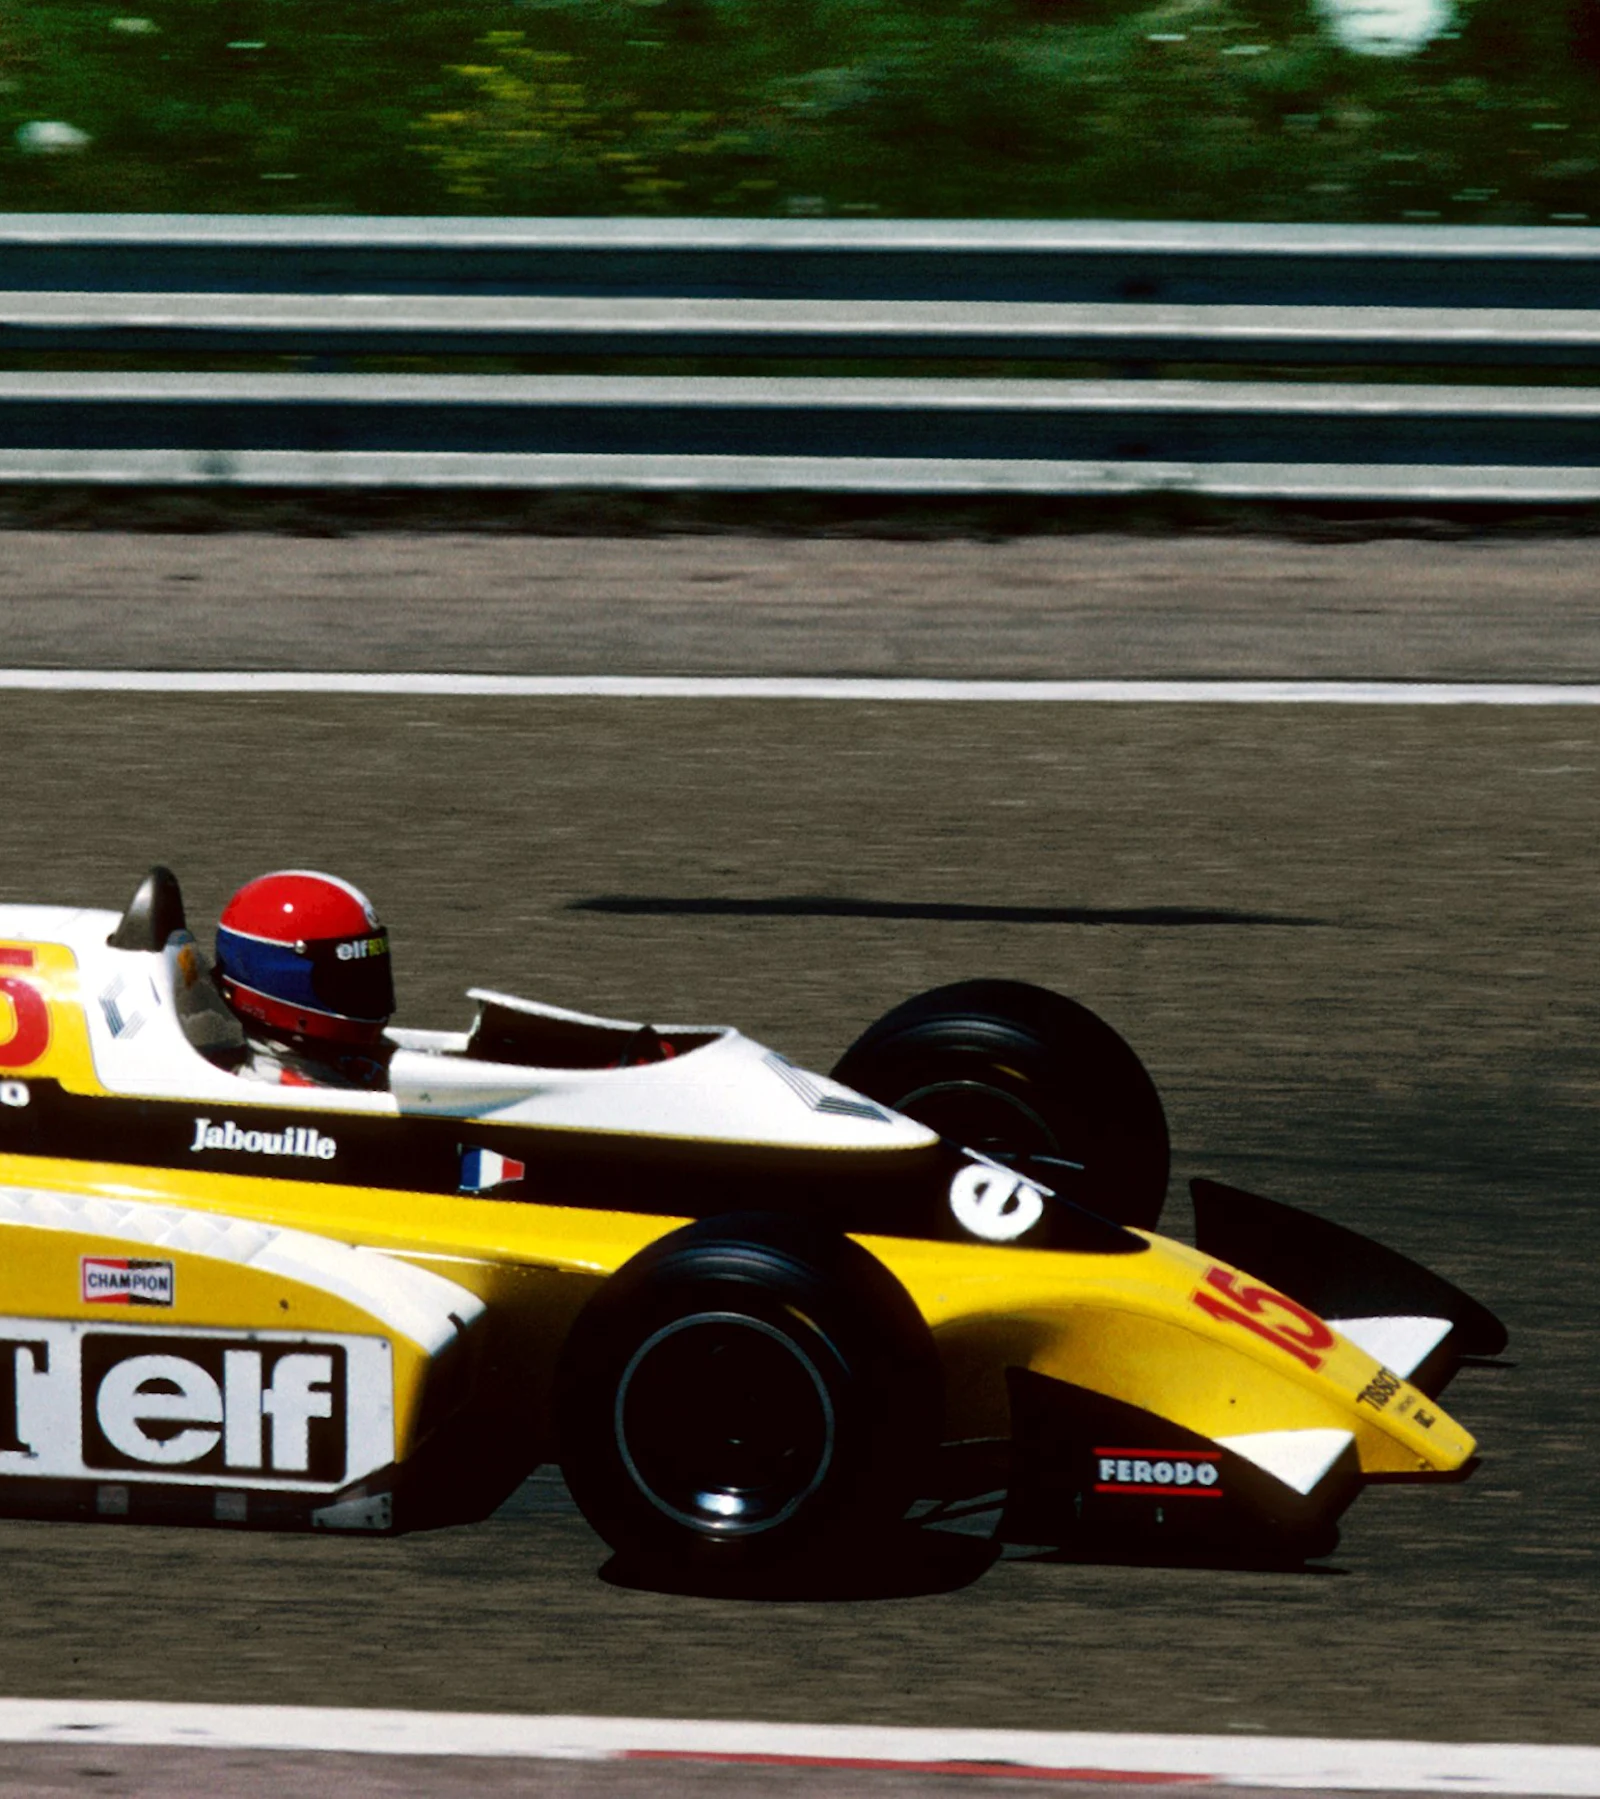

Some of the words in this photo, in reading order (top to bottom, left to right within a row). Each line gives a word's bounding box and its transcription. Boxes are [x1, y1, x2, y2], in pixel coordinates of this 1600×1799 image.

[335, 941, 368, 961] elf
[190, 1118, 337, 1160] Jabouille
[87, 1273, 168, 1291] CHAMPION
[1193, 1266, 1334, 1370] 15
[96, 1350, 333, 1472] elf
[1099, 1459, 1219, 1486] FERODO
